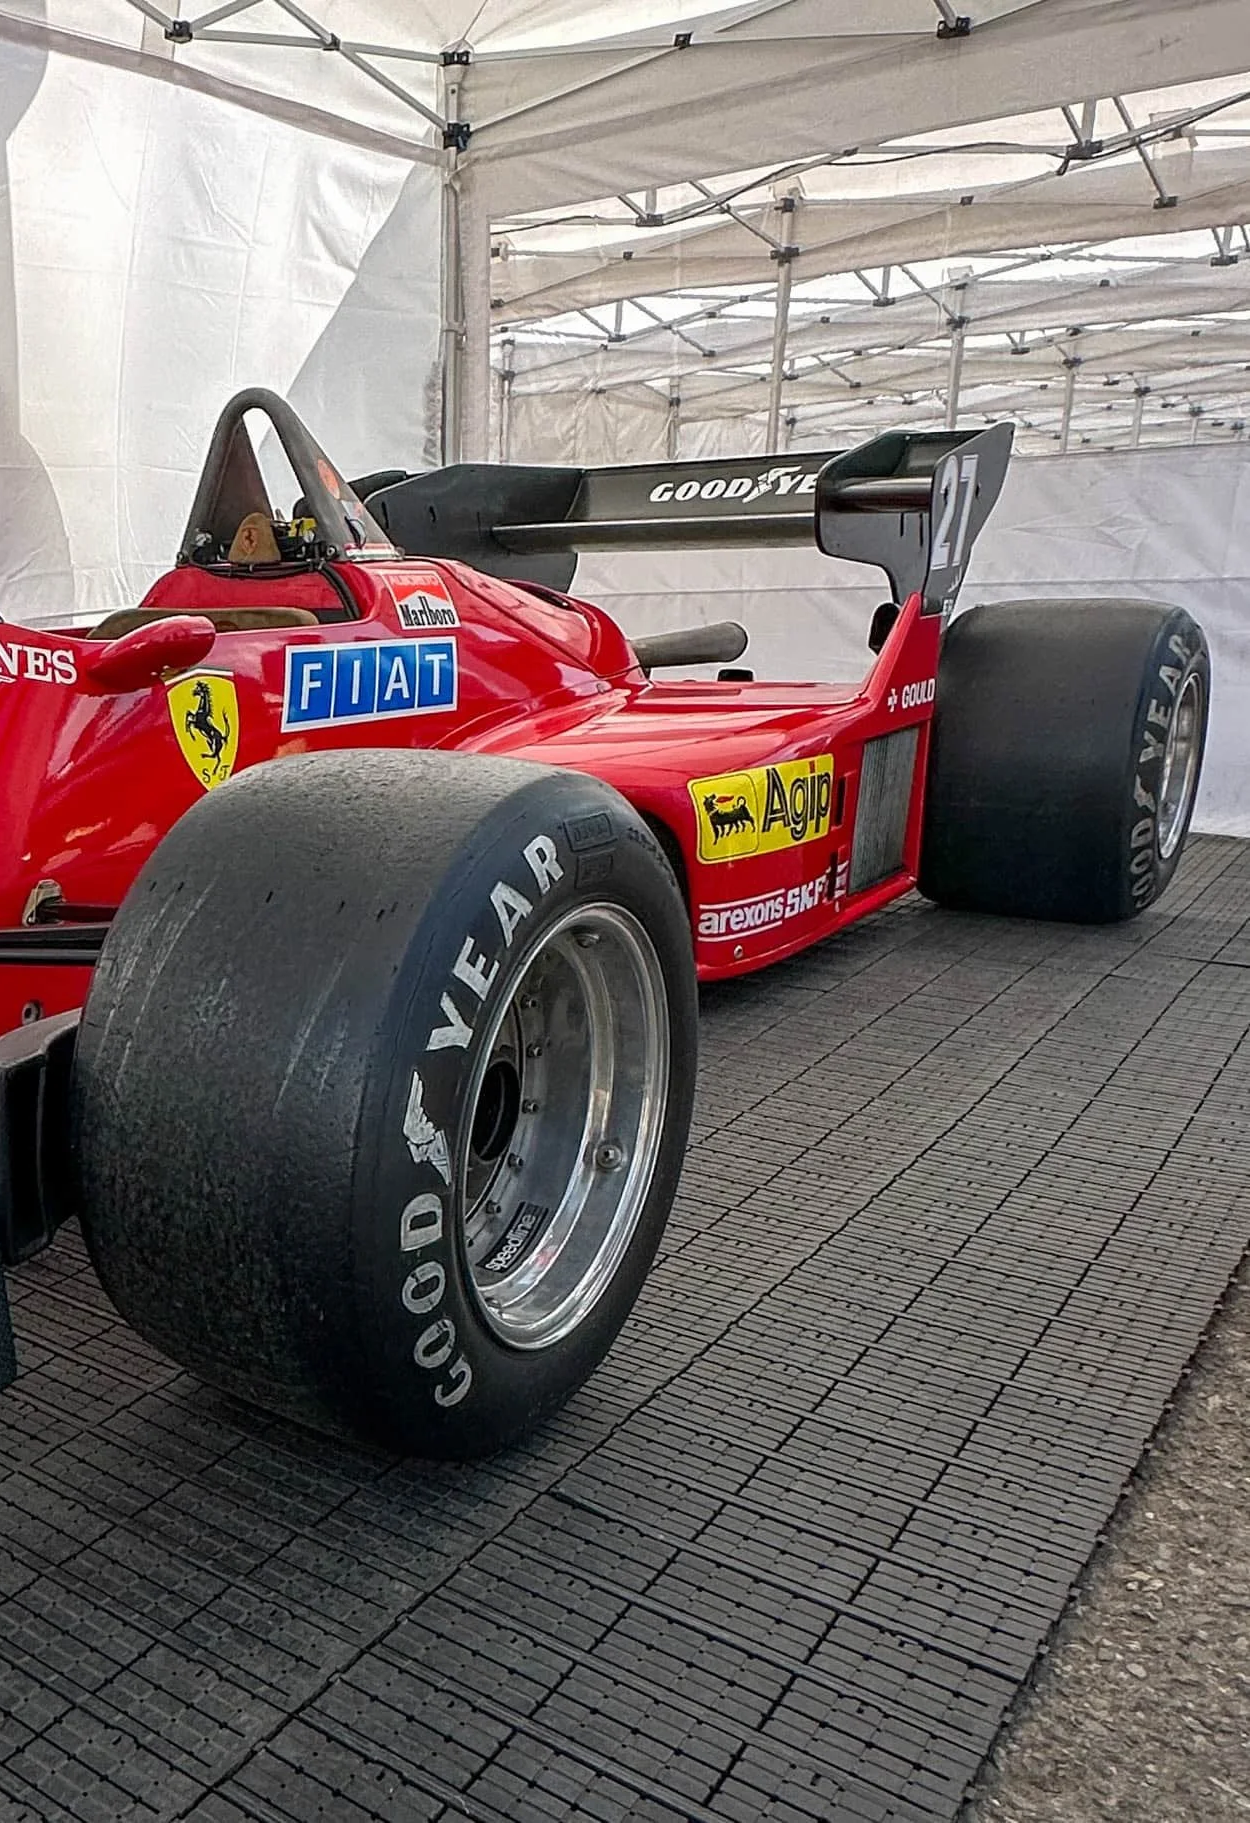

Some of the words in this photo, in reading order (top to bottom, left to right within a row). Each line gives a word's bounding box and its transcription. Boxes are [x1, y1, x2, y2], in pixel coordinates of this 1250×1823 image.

[929, 453, 979, 570] 27
[399, 596, 456, 626] Marlboro
[300, 653, 448, 710] FIAT
[902, 678, 936, 709] GOULD
[202, 768, 212, 784] S
[762, 760, 831, 841] Agip
[698, 894, 784, 935] arexons
[784, 875, 827, 919] SKF
[426, 834, 564, 1051] YEAR
[485, 1214, 536, 1271] speedline
